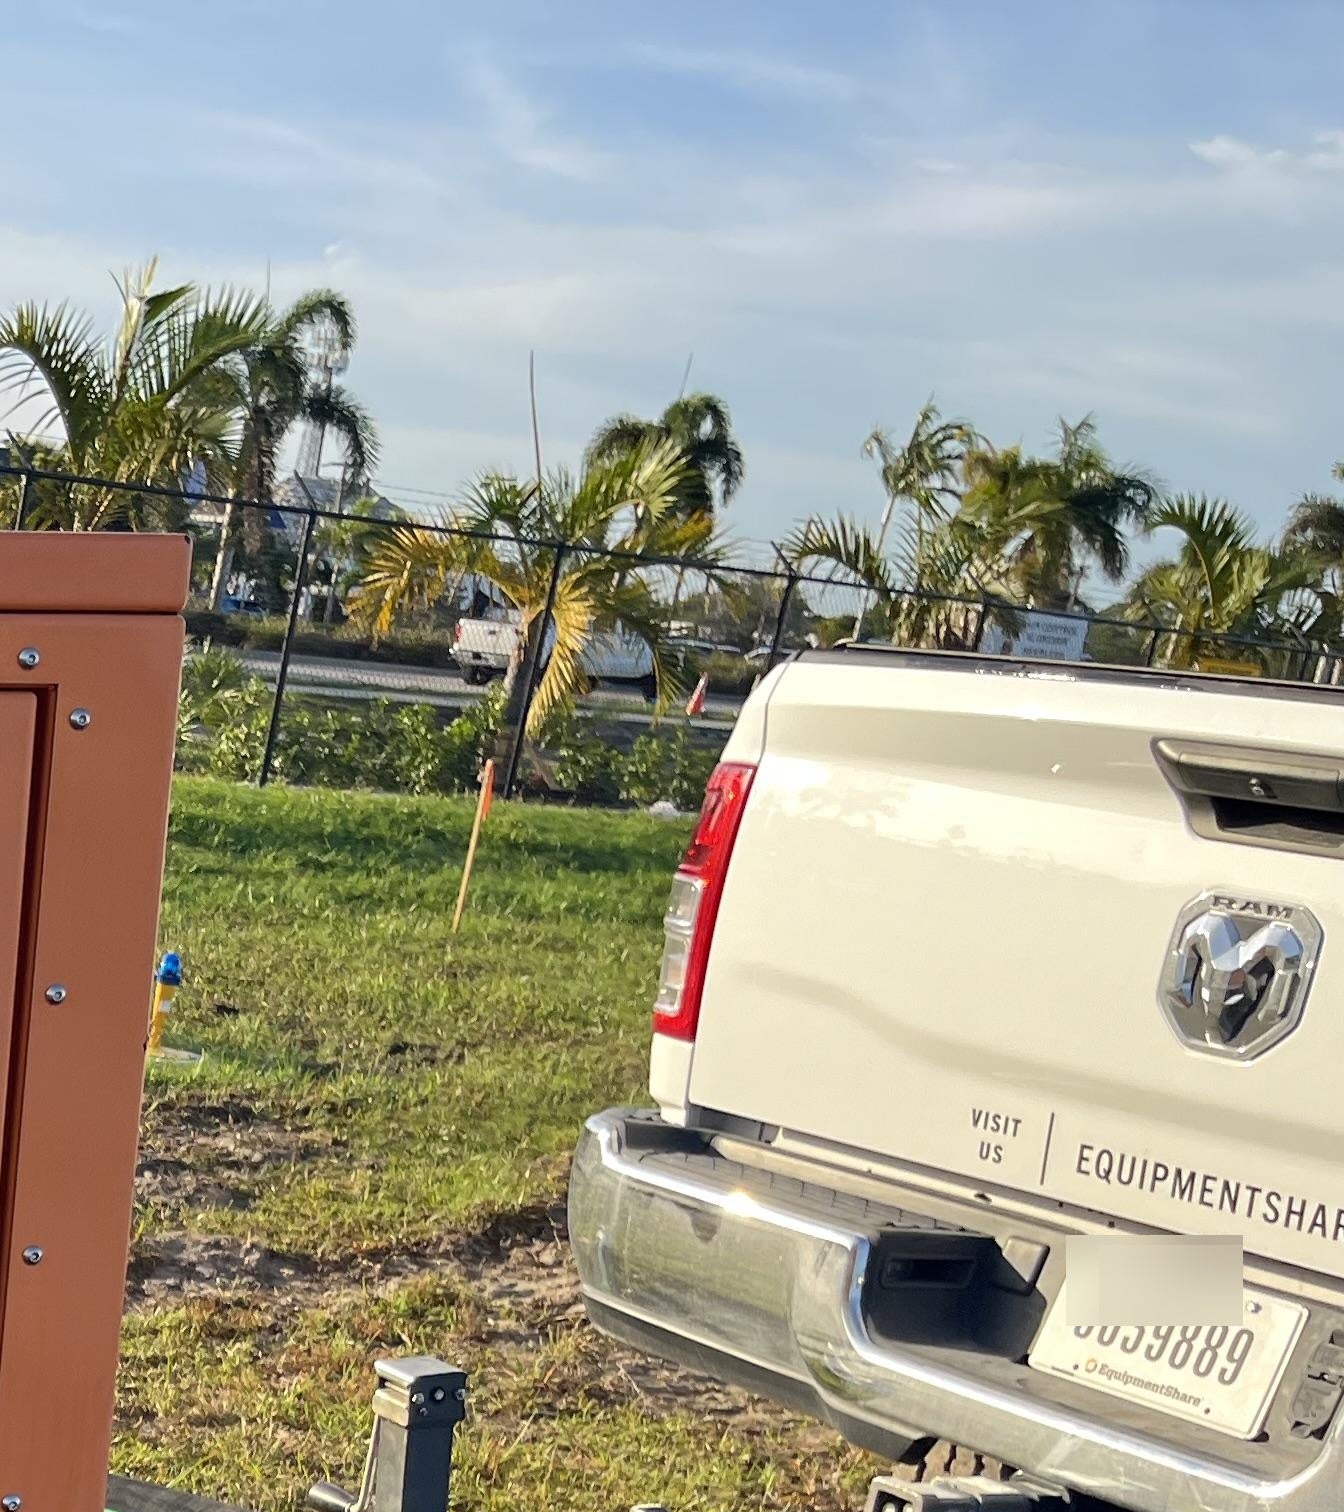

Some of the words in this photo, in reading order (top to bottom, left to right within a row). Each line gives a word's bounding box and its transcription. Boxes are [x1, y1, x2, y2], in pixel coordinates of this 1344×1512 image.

[1213, 896, 1293, 918] RAM
[971, 1108, 1022, 1137] VISIT
[978, 1141, 1003, 1164] US
[1098, 1363, 1201, 1406] EquipmentShare
